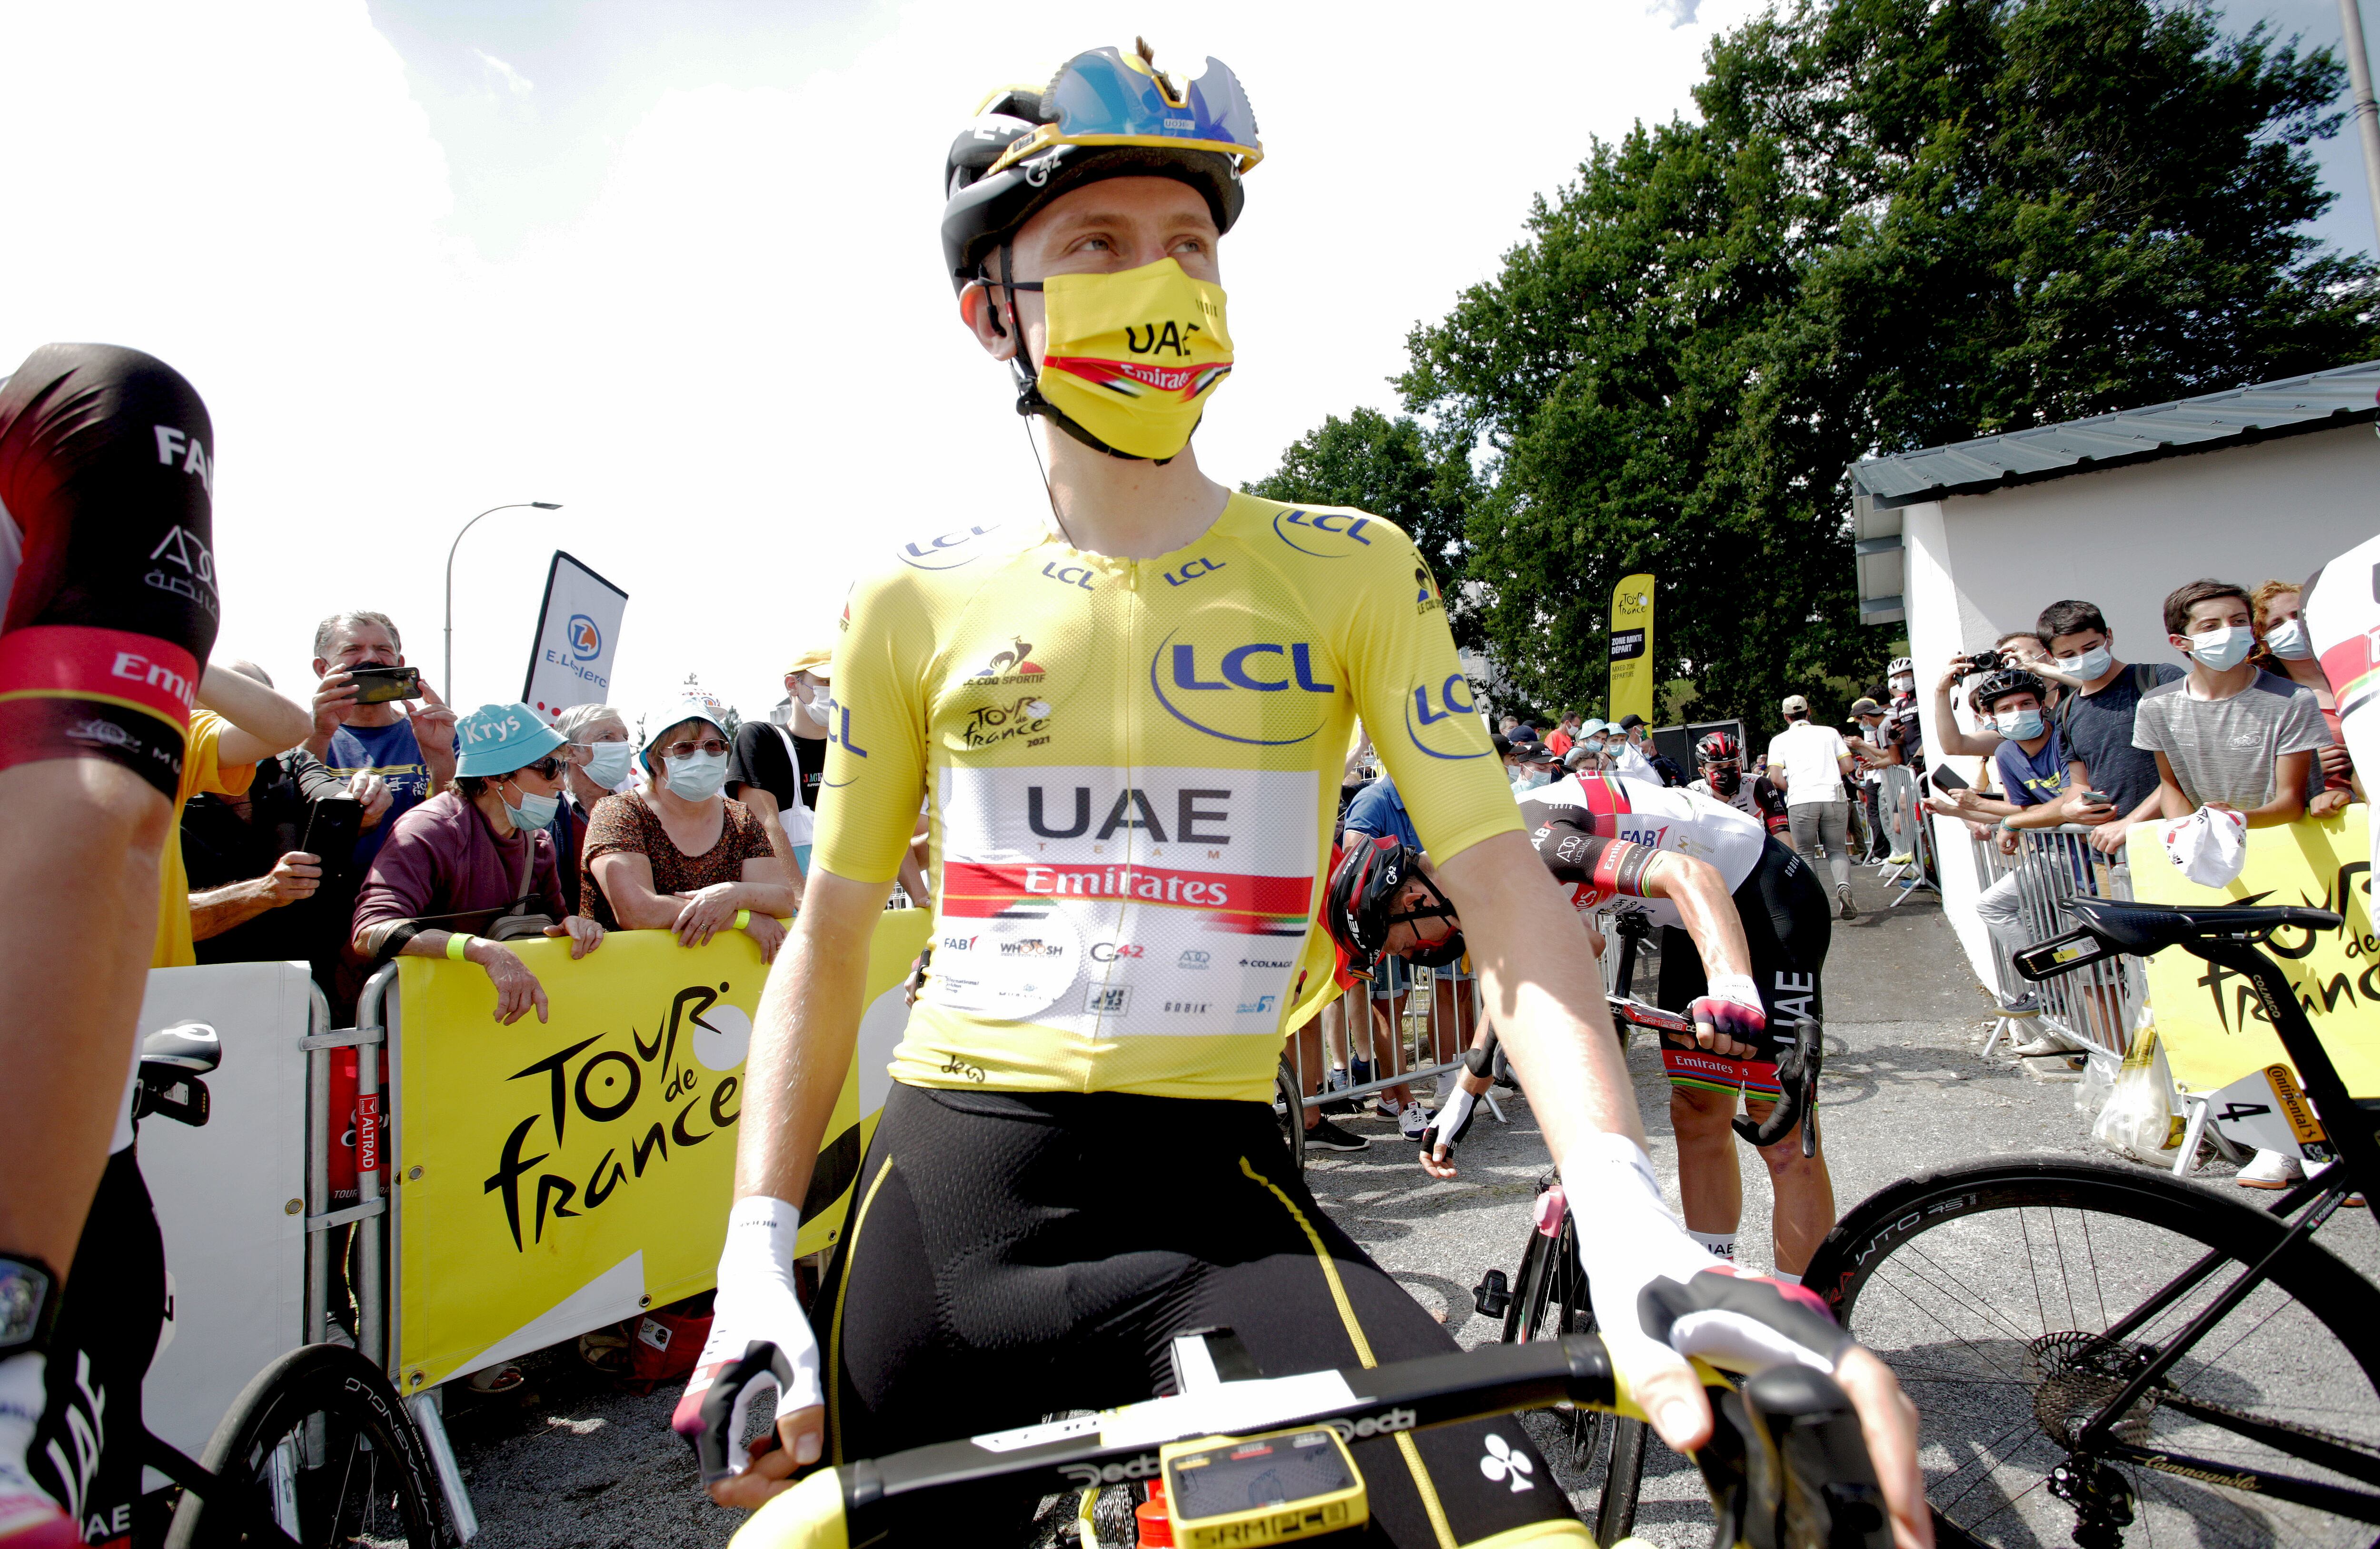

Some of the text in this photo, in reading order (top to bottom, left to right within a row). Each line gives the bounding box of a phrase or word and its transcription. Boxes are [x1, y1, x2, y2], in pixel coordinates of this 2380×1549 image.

[154, 424, 213, 499] FA
[905, 524, 1001, 557] LCL
[1287, 510, 1371, 545] LCL
[1041, 561, 1096, 591] LCL
[1163, 557, 1227, 587] LCL
[1618, 600, 1646, 616] france
[1611, 634, 1642, 646] ZONE MIXTE
[977, 677, 999, 685] COQ
[1002, 674, 1046, 684] SPORTIF
[1172, 642, 1335, 693] LCL
[1612, 664, 1626, 672] MIXED
[1612, 671, 1634, 681] DEPARTURE
[968, 696, 1042, 729] TOUR
[1414, 673, 1474, 725] LC
[463, 715, 522, 745] Krys
[1015, 714, 1028, 724] de
[963, 719, 1051, 750] france
[1027, 736, 1051, 748] 2021
[1027, 787, 1232, 844] UAE
[1038, 843, 1220, 859] TEAM
[1386, 866, 1397, 885] G42
[1785, 855, 1800, 878] GOBIK
[1025, 867, 1228, 906] Emirates
[1346, 909, 1367, 949] MET
[2345, 926, 2380, 958] de
[1090, 942, 1144, 963] G42
[1251, 960, 1292, 968] COLNAGO
[1165, 1002, 1207, 1014] GOBIK
[2253, 973, 2281, 1019] COLNAGO
[505, 981, 730, 1149] TOUR
[1675, 1055, 1734, 1074] Emirates
[665, 1063, 698, 1102] de
[2216, 1103, 2271, 1122] 4
[2267, 1066, 2312, 1132] Continental
[362, 1116, 375, 1169] ALTRAD
[484, 1074, 744, 1253] france
[1928, 1200, 1964, 1214] 45
[411, 1427, 425, 1459] CORSA
[2132, 1455, 2262, 1491] Campagnolo
